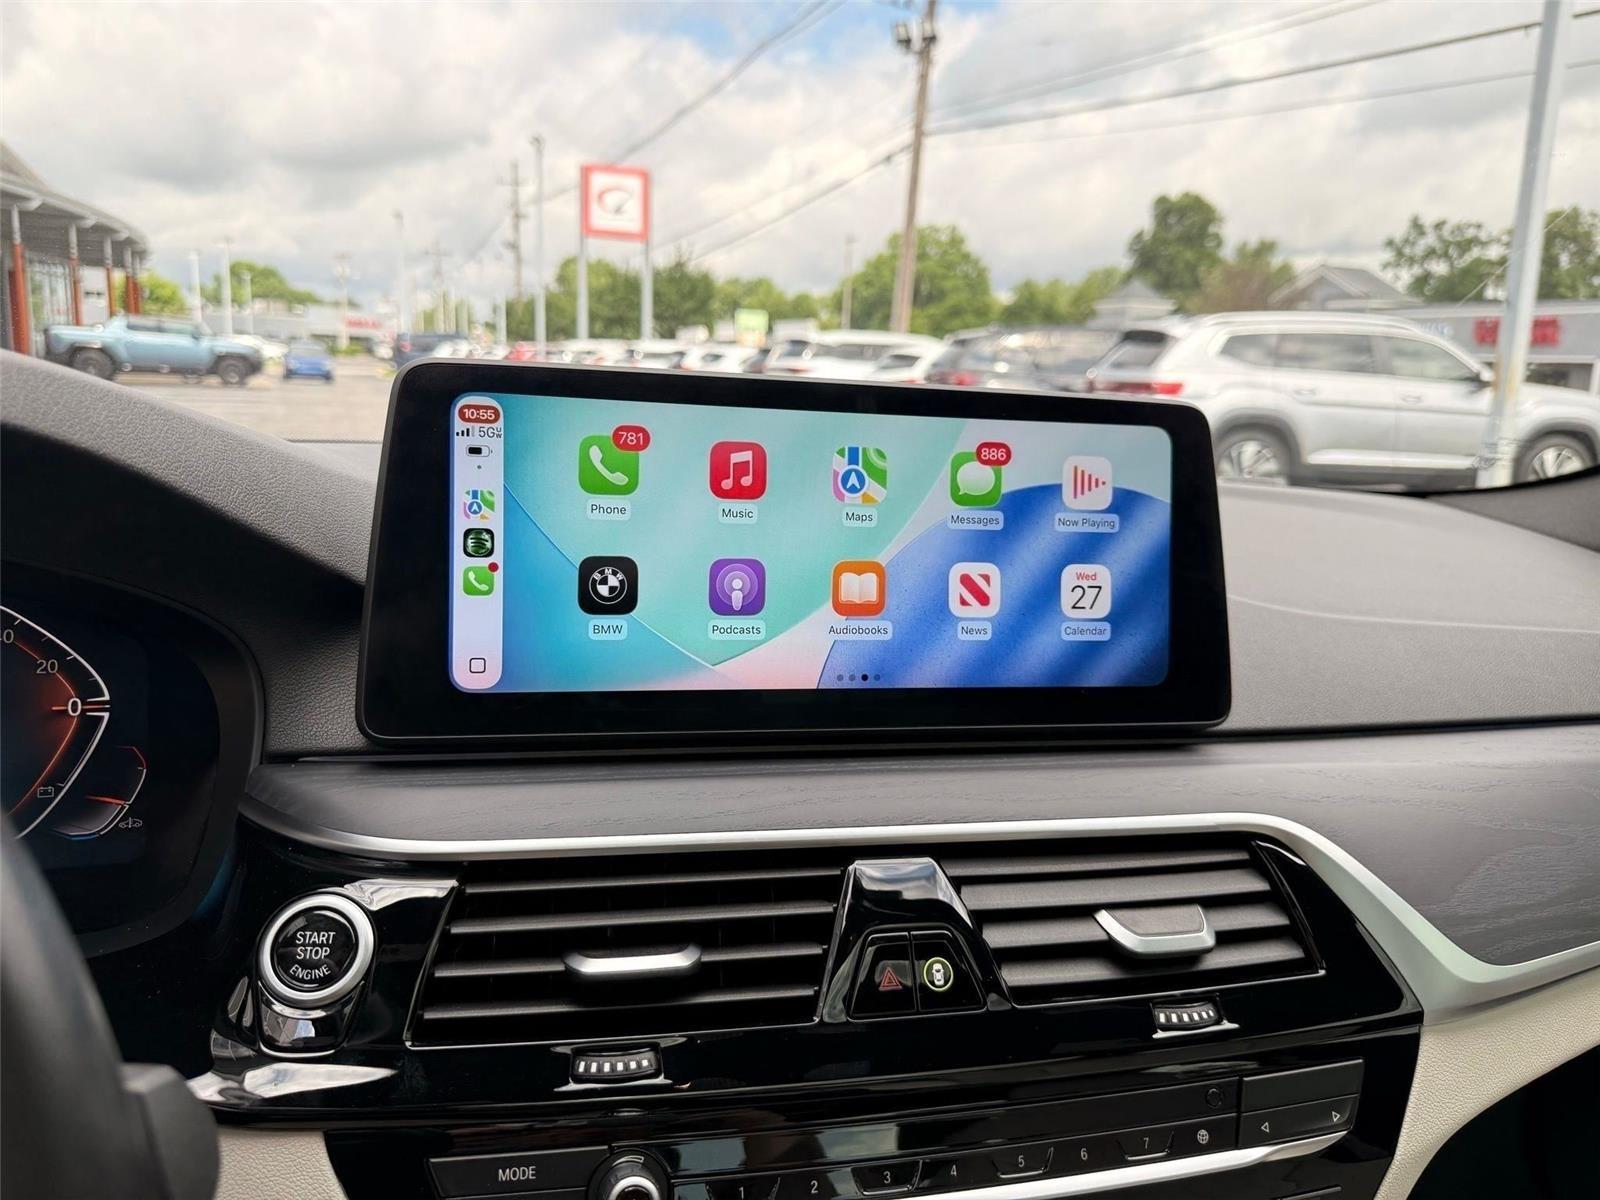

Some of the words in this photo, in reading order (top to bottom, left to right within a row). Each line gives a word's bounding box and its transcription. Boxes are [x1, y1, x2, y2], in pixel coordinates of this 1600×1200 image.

[463, 409, 495, 420] 10:55
[618, 432, 644, 445] 781
[981, 448, 1007, 460] 886
[591, 504, 627, 515] Phone
[722, 508, 753, 519] Music
[845, 512, 873, 524] Maps
[951, 515, 1000, 527] Messages
[1058, 518, 1078, 527] Now
[1082, 518, 1115, 529] Playing
[1076, 572, 1097, 581] Wed
[1070, 585, 1102, 610] 27
[593, 624, 623, 634] BMW
[712, 624, 761, 635] Podcasts
[828, 625, 888, 635] Audiobooks
[961, 626, 988, 636] News
[1064, 626, 1107, 636] Calendar
[0, 629, 14, 643] 0
[36, 659, 58, 674] 20
[67, 697, 82, 716] 0
[295, 931, 336, 944] START
[296, 946, 330, 960] STOP
[290, 964, 331, 980] ENGINE
[1143, 1137, 1149, 1149] 7
[1080, 1148, 1088, 1161] 6
[1018, 1155, 1025, 1167] 5
[498, 1166, 537, 1182] MODE
[950, 1164, 957, 1177] 4
[883, 1171, 891, 1184] 3
[739, 1186, 745, 1199] 1
[810, 1180, 818, 1194] 2
